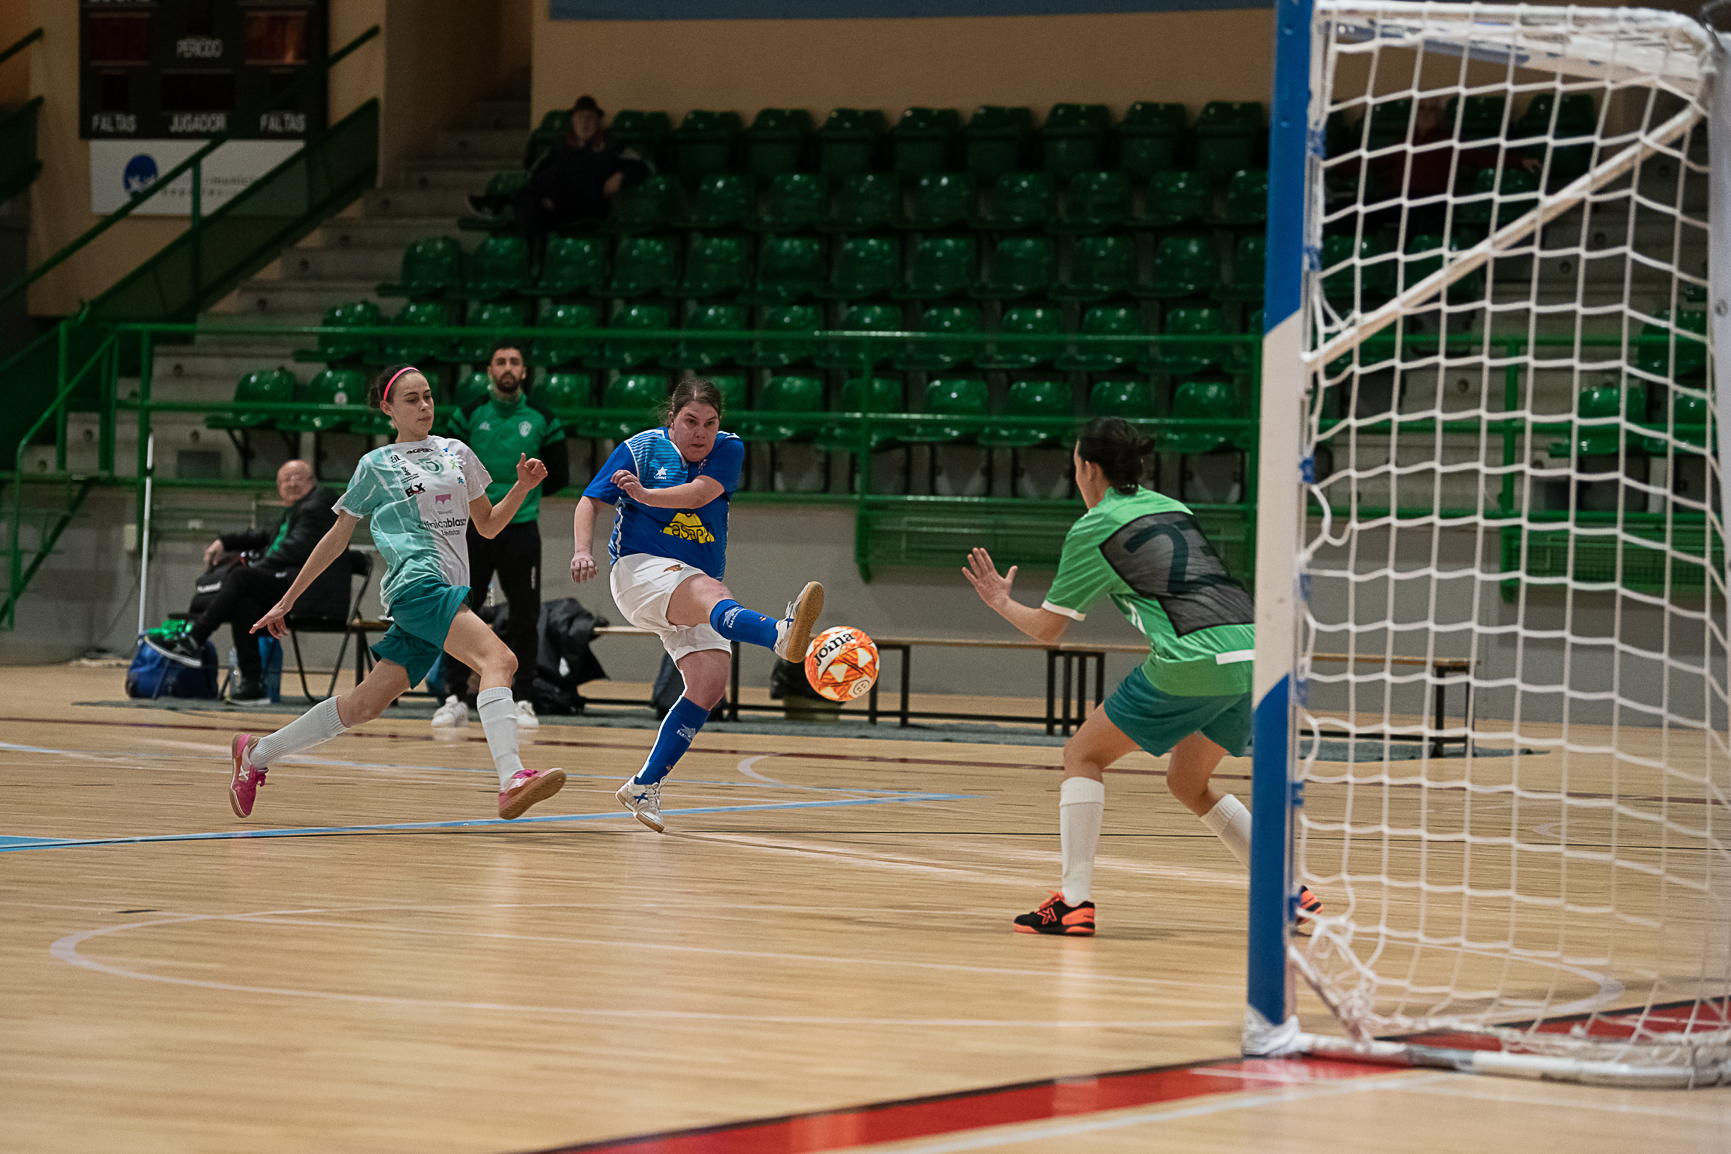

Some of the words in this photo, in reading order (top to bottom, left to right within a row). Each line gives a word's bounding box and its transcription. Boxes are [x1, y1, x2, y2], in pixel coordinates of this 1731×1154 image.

[176, 38, 223, 58] PERIODO
[91, 113, 138, 133] FALTAS
[169, 113, 227, 133] JUGADOR
[259, 113, 307, 133] FALTAS
